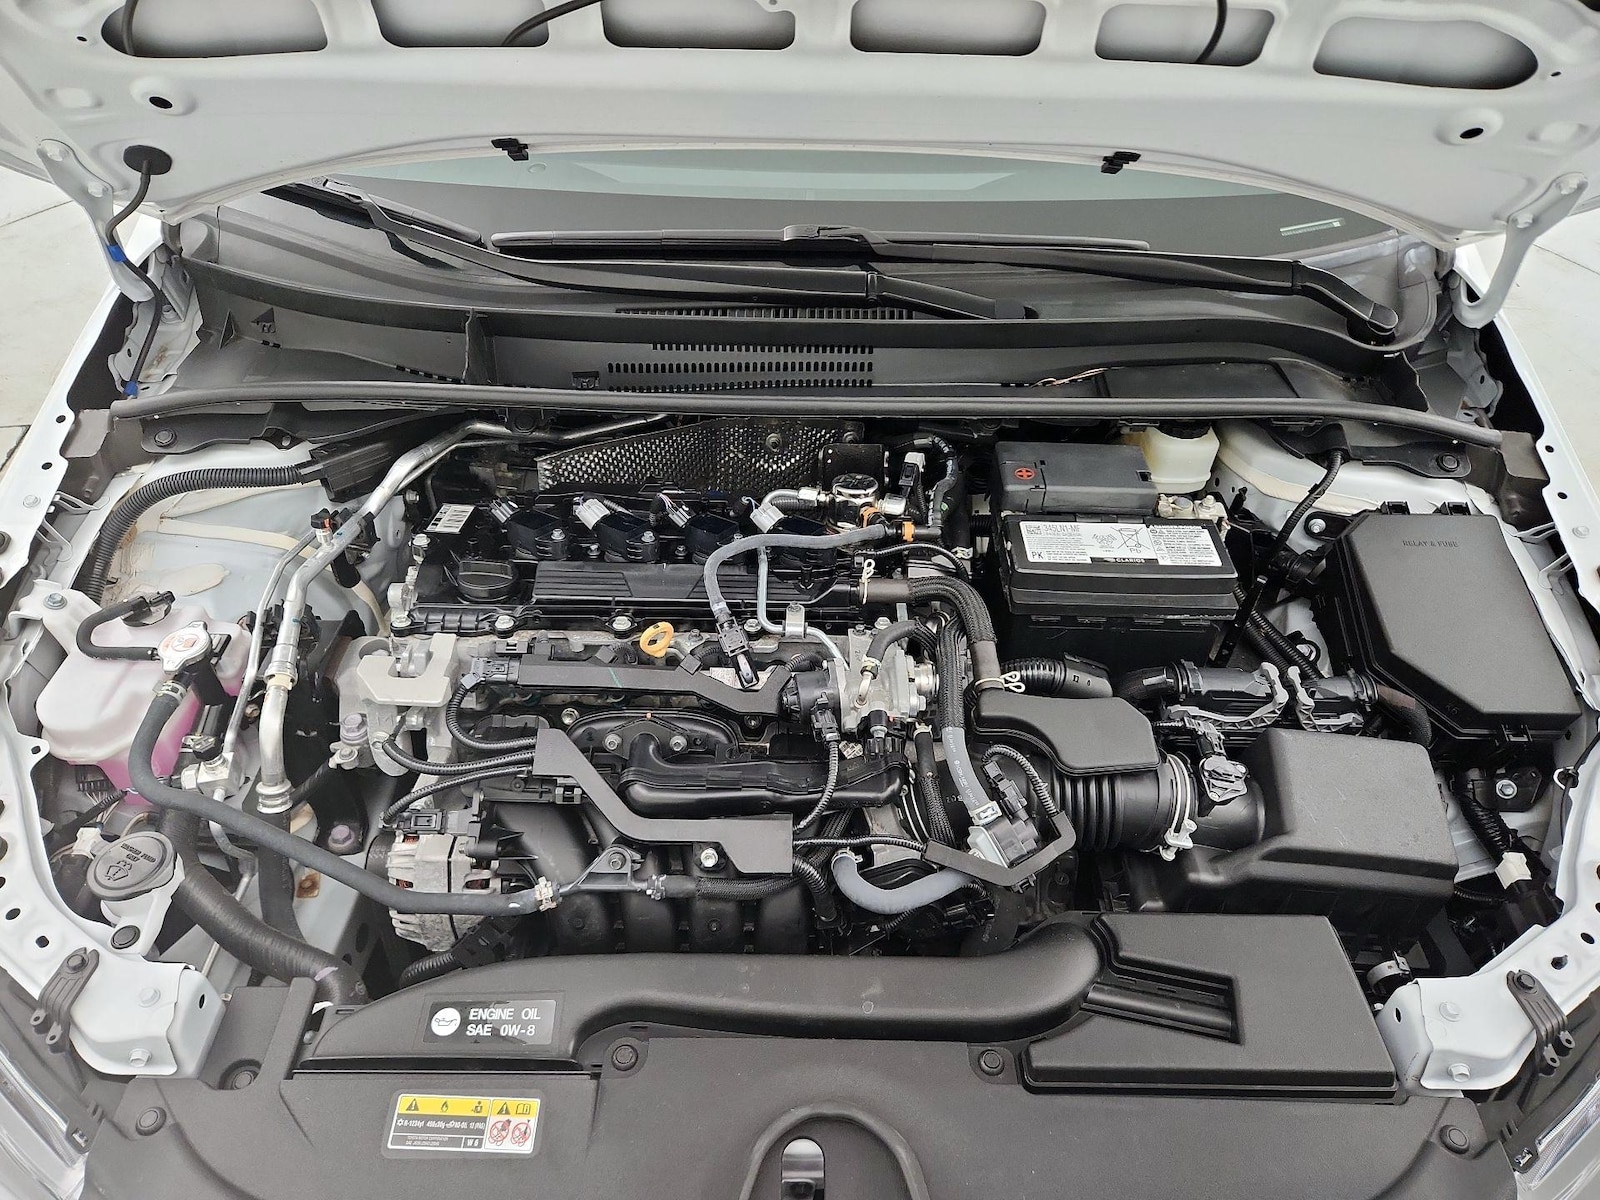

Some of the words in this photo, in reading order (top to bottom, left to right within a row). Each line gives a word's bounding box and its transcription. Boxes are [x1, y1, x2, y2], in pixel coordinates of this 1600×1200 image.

[1437, 540, 1459, 548] FUSE
[1031, 551, 1043, 559] PK
[468, 1008, 514, 1020] ENGINE
[521, 1008, 541, 1020] OIL
[466, 1024, 492, 1036] SAE
[500, 1024, 535, 1036] 0W-8
[467, 1138, 474, 1146] W
